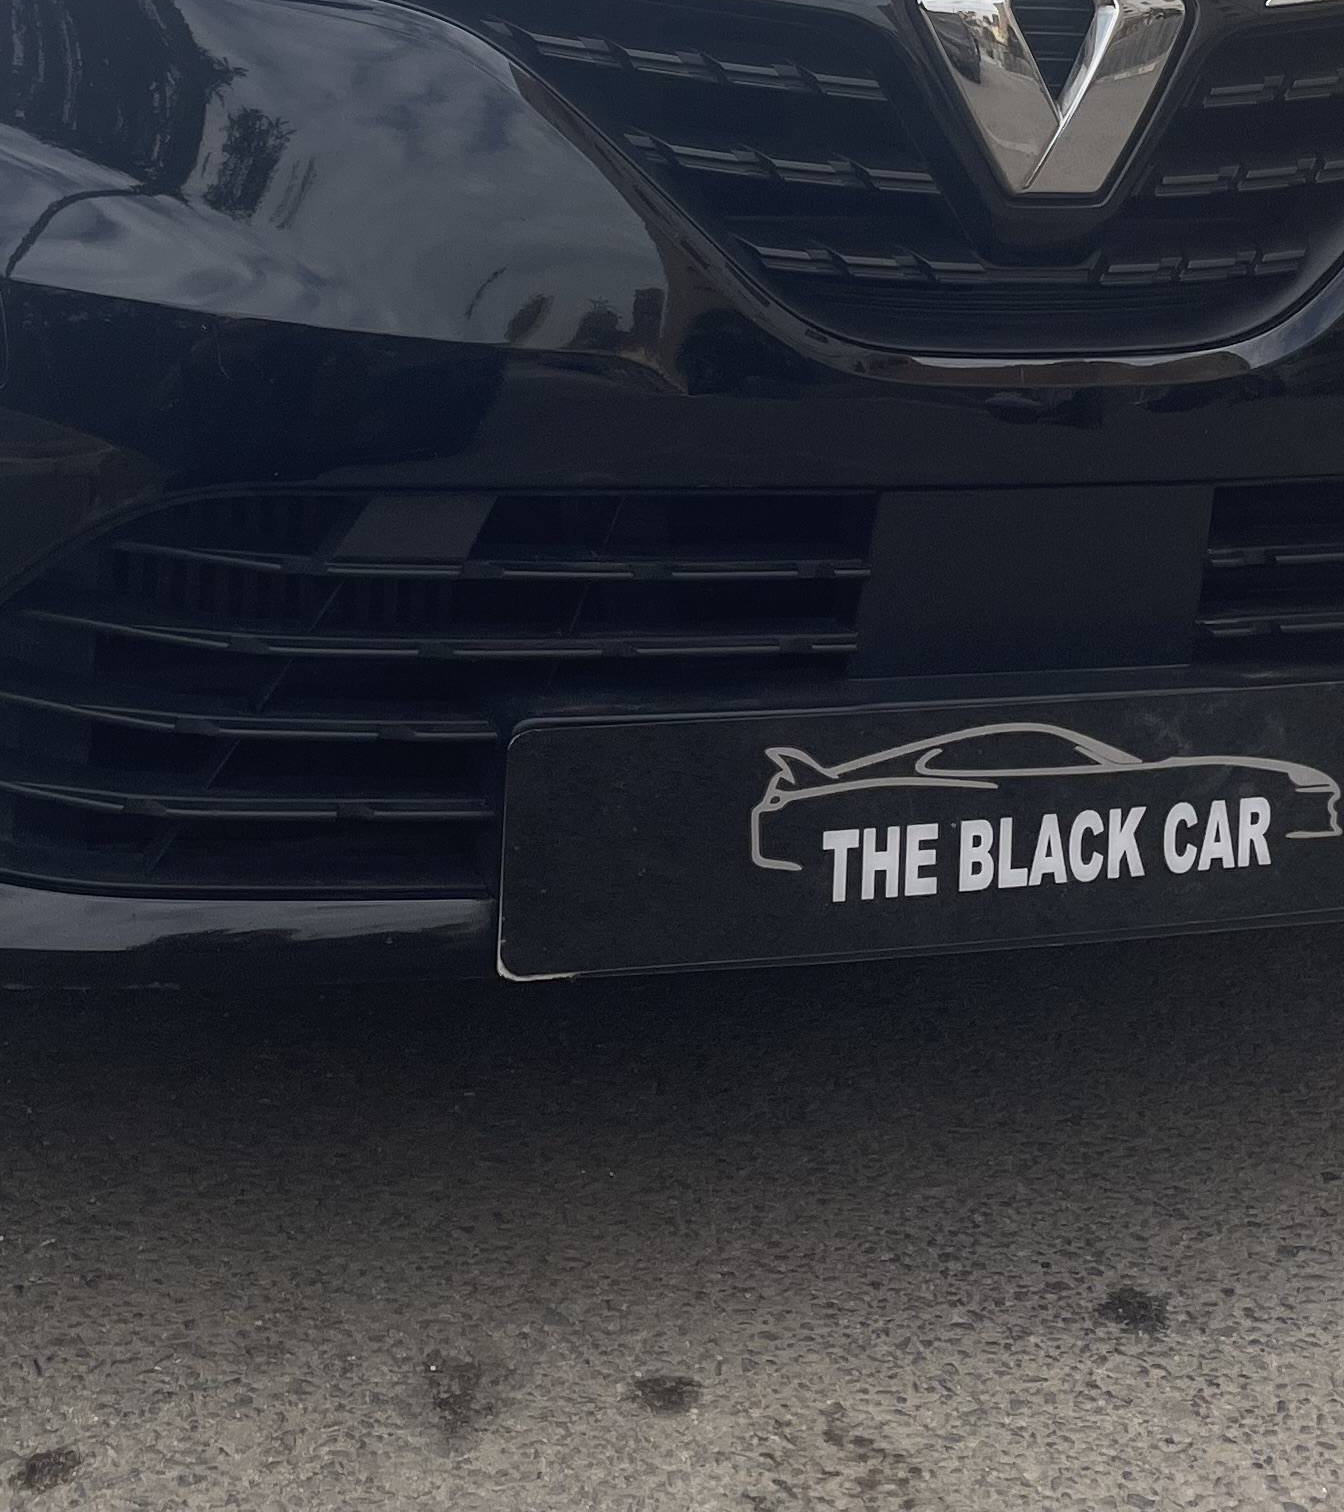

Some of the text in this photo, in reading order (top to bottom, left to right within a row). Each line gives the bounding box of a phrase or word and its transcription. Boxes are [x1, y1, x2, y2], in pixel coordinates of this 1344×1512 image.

[822, 796, 1272, 903] THE BLACK CAR
